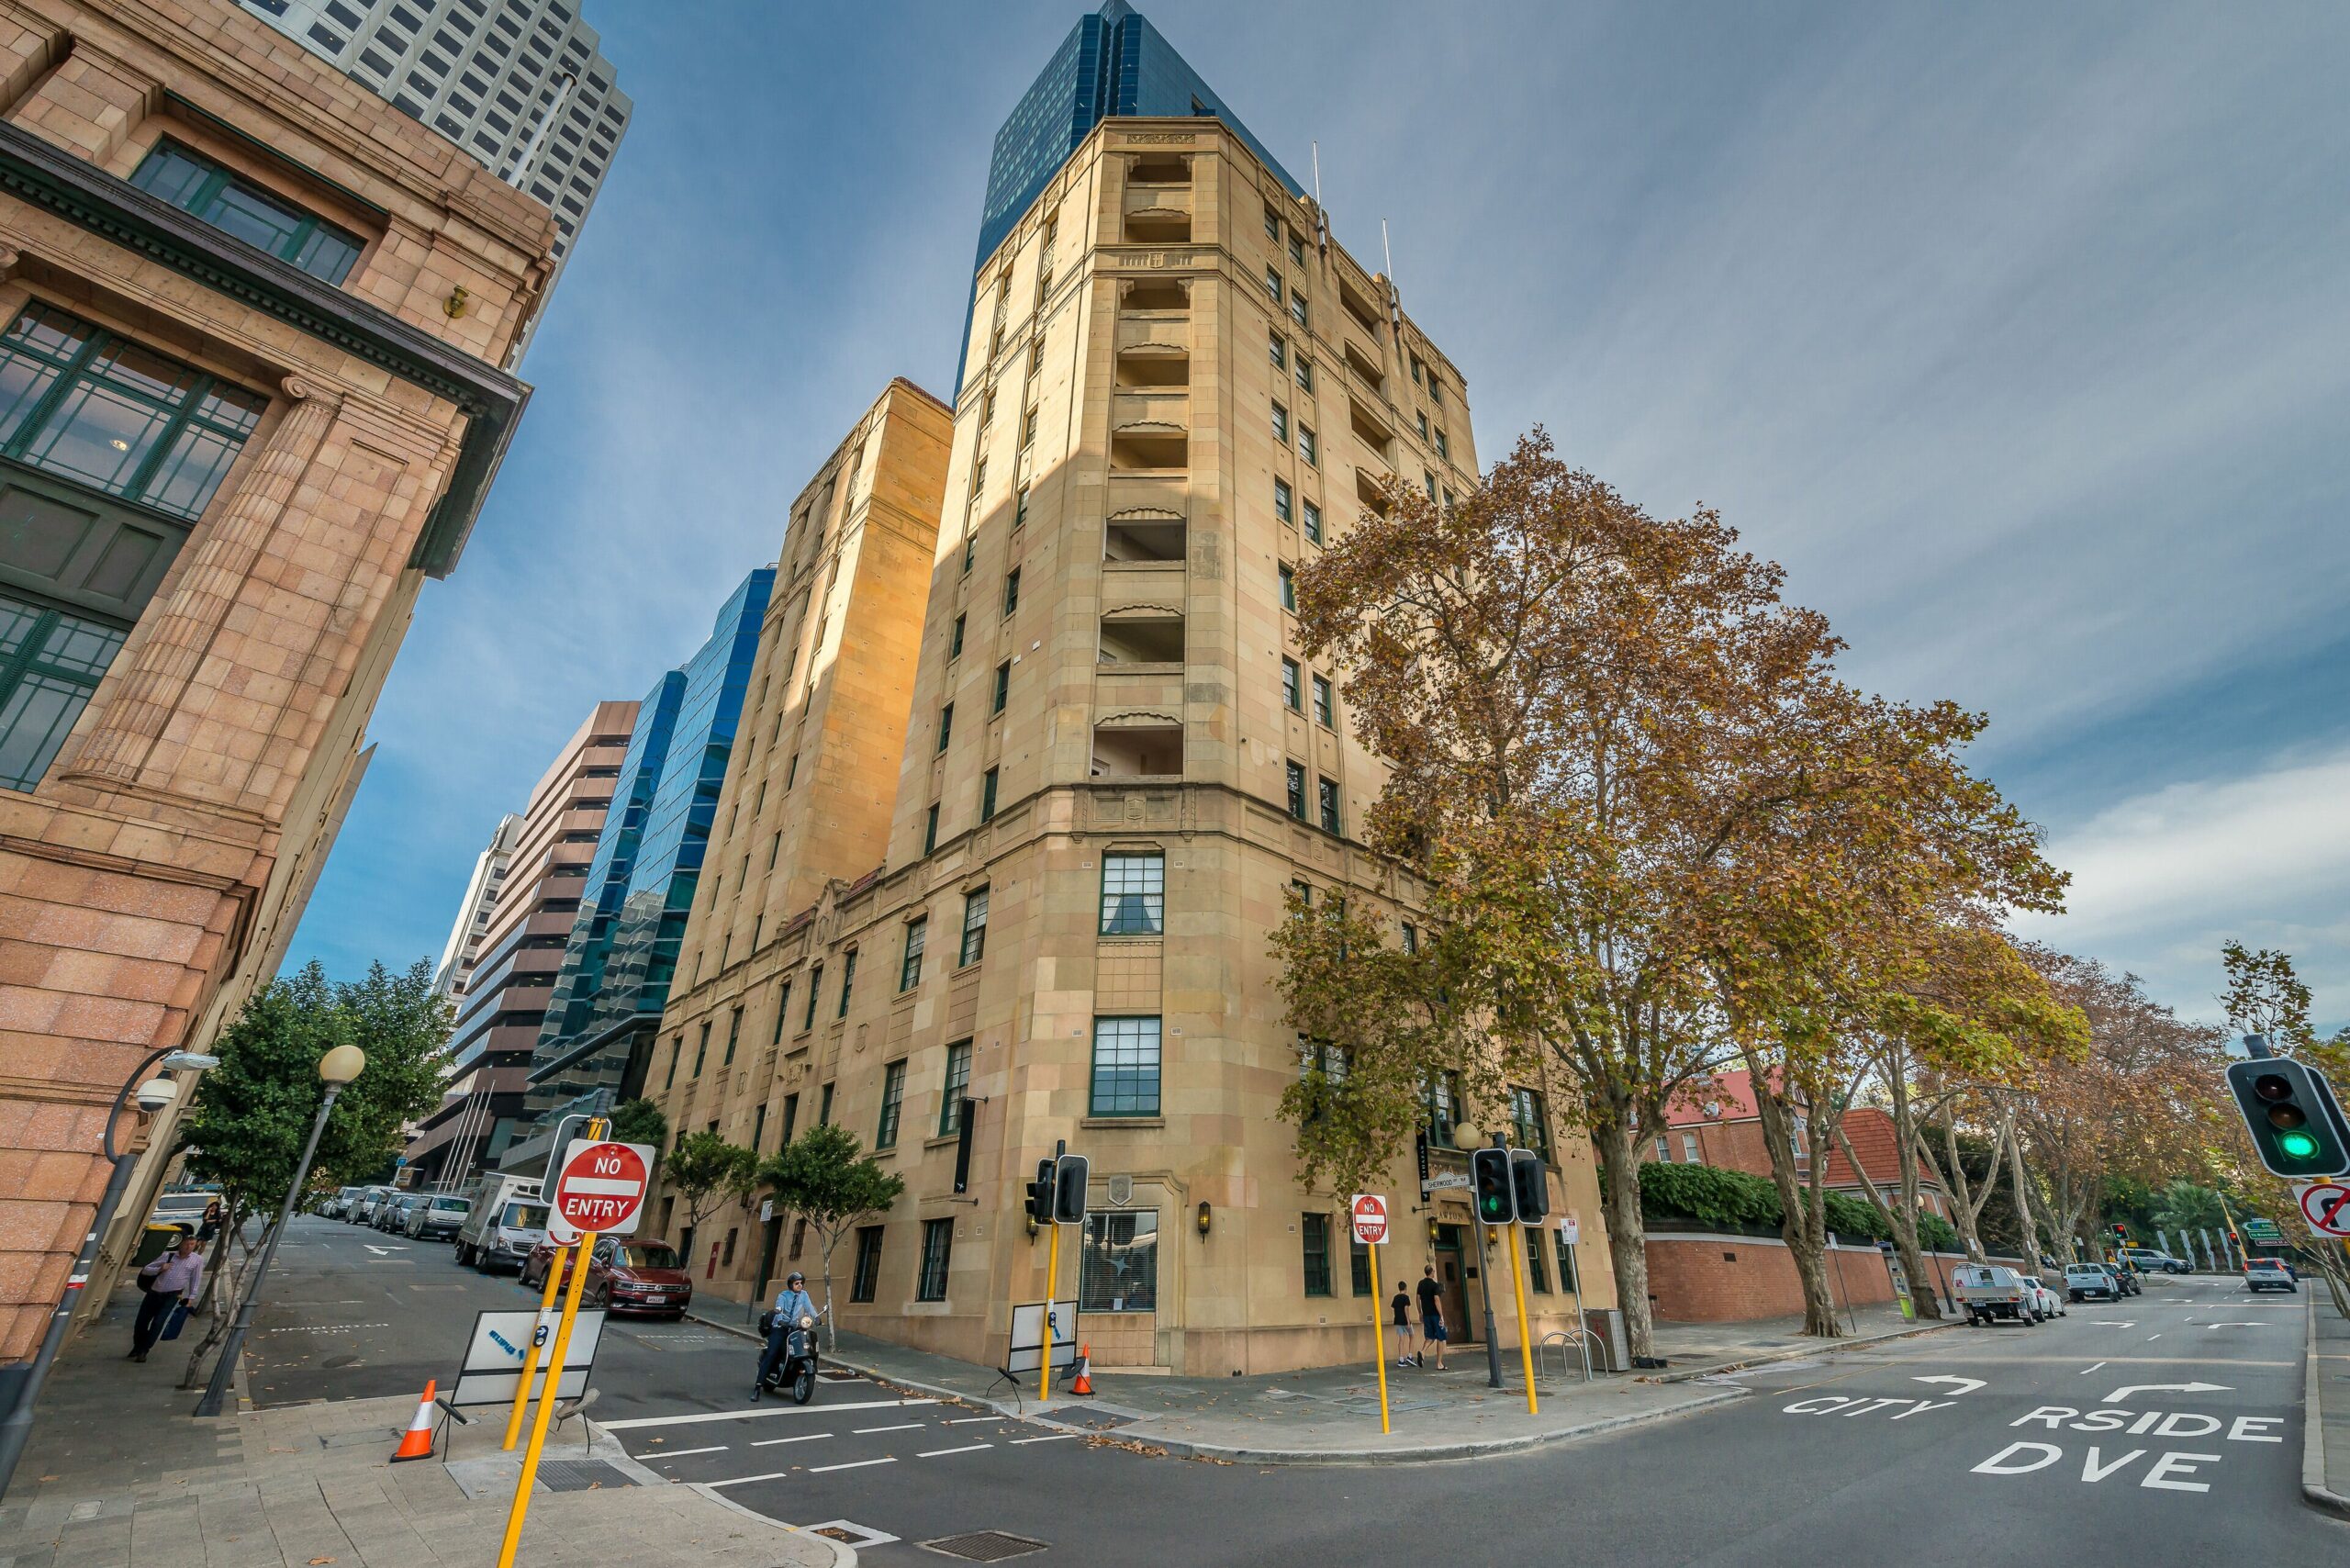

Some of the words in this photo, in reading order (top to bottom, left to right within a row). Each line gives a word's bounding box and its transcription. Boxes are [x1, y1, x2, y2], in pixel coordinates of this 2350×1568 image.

[594, 1158, 621, 1175] NO
[1427, 1180, 1452, 1189] SHERWOOD
[565, 1198, 630, 1217] ENTRY
[1364, 1204, 1375, 1214] NO
[1359, 1226, 1382, 1236] ENTRY
[1783, 1396, 1957, 1419] CITY
[2009, 1406, 2284, 1443] RSIDE
[1970, 1441, 2221, 1492] DVE
